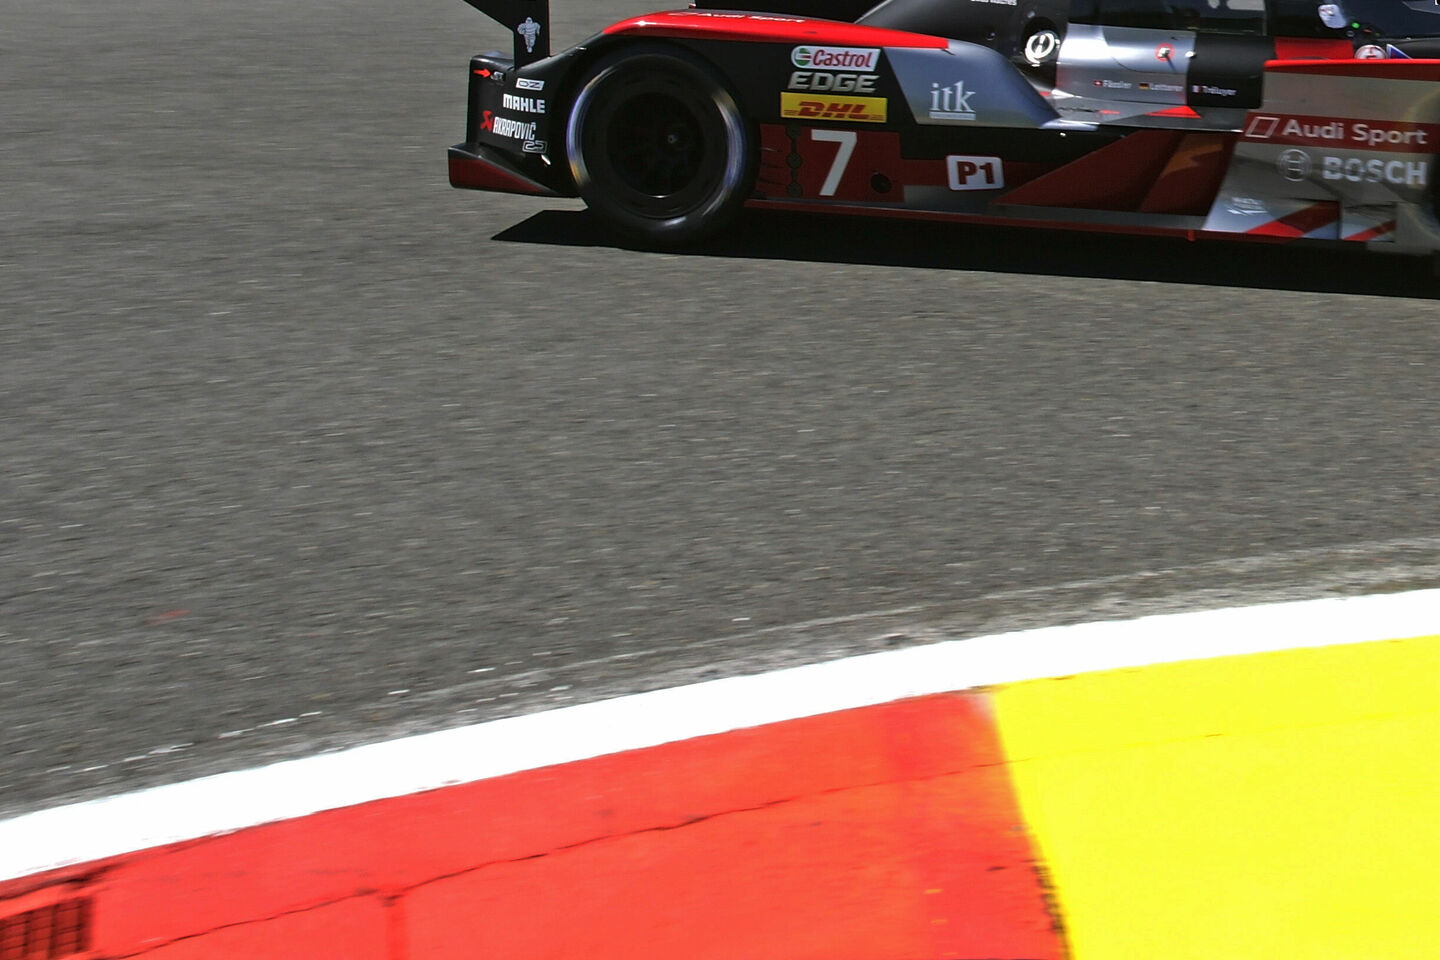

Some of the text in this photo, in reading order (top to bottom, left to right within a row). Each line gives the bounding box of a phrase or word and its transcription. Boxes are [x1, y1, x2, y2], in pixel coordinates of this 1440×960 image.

[812, 49, 873, 68] Castrol
[788, 71, 881, 93] EDGE
[503, 93, 545, 113] MAHLE
[930, 81, 977, 113] itk
[797, 101, 872, 120] DHL
[1282, 119, 1428, 146] Audi Sport
[811, 129, 858, 196] 7
[956, 160, 996, 185] P1
[1322, 156, 1427, 185] BOSCH
